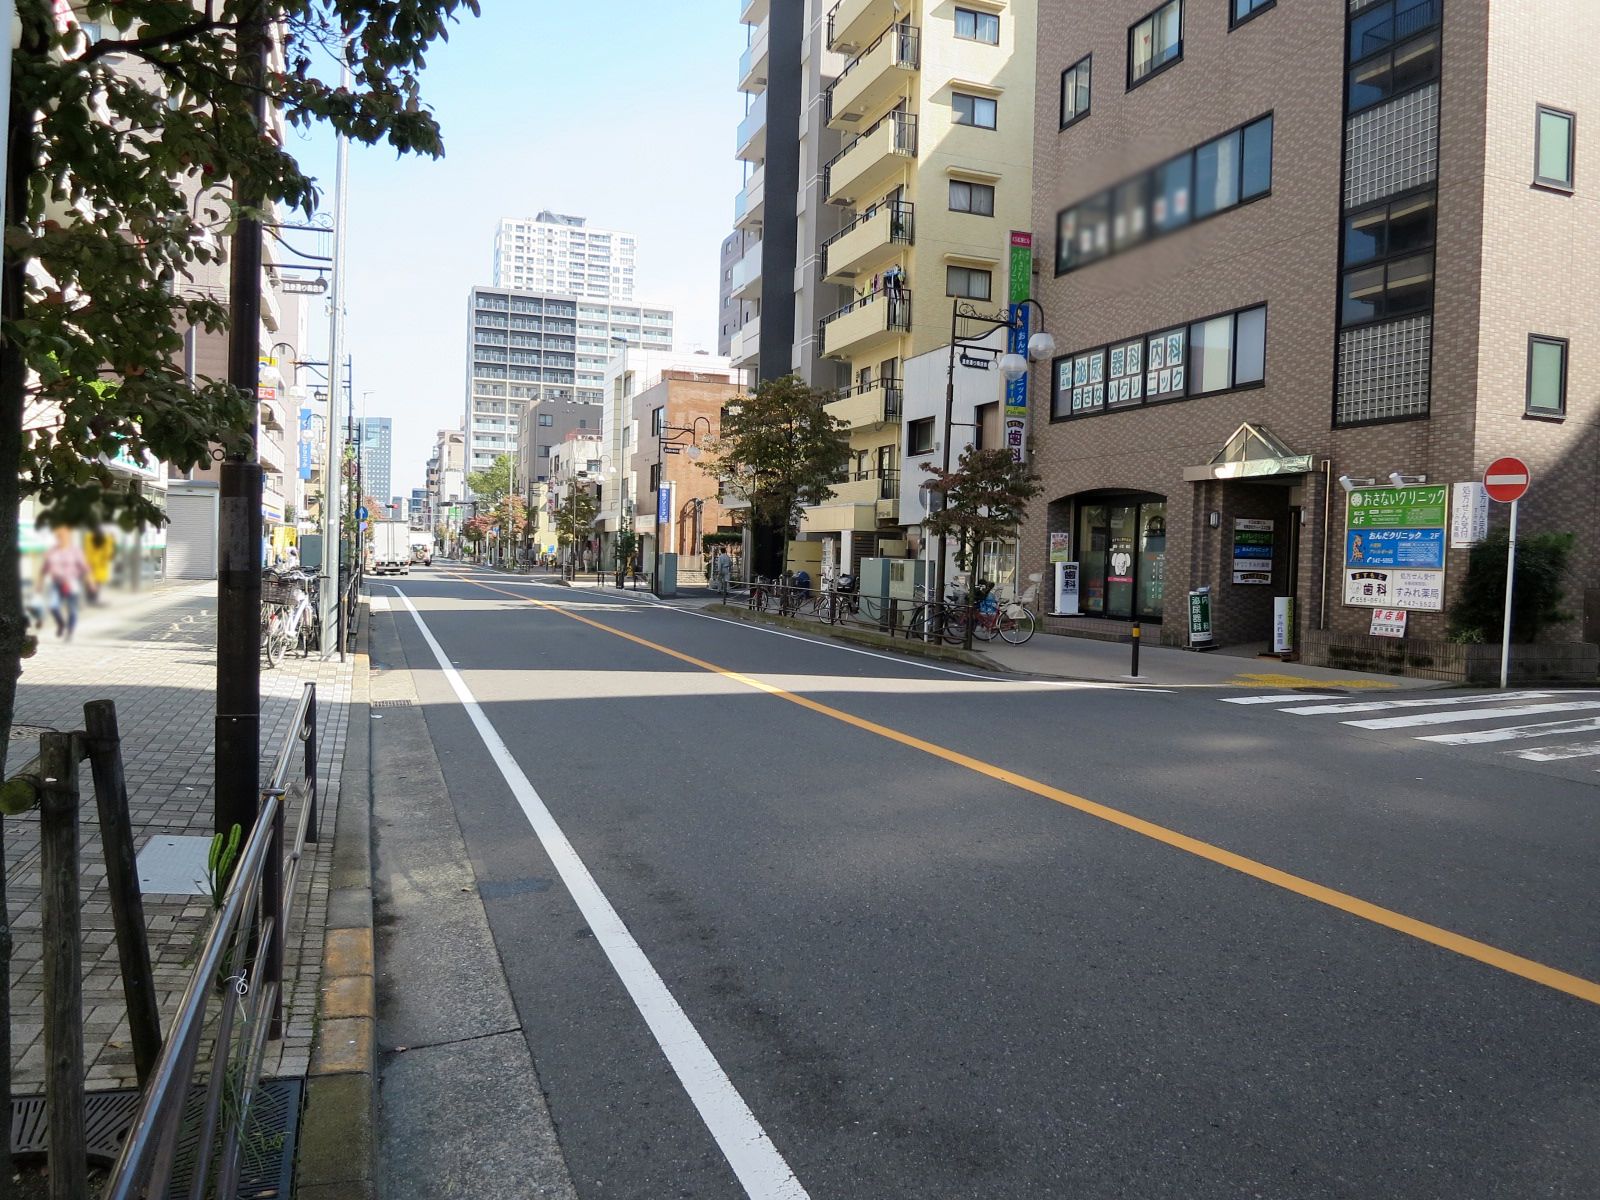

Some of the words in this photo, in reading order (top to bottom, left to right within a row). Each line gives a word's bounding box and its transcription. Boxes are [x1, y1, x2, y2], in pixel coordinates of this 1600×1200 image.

[1074, 369, 1183, 409] おさないクリニック
[1363, 489, 1445, 506] おさないクリニック
[1352, 516, 1365, 525] 4F
[1368, 531, 1422, 540] おんだクリニック
[1430, 532, 1440, 540] 2F
[1400, 573, 1436, 581] 処方せん受付
[1363, 583, 1387, 596] 歯科
[1395, 588, 1440, 600] すみれ薬局
[1191, 596, 1202, 632] 泌尿器科
[1201, 596, 1209, 630] 内科
[1374, 609, 1405, 622] 貸店舗
